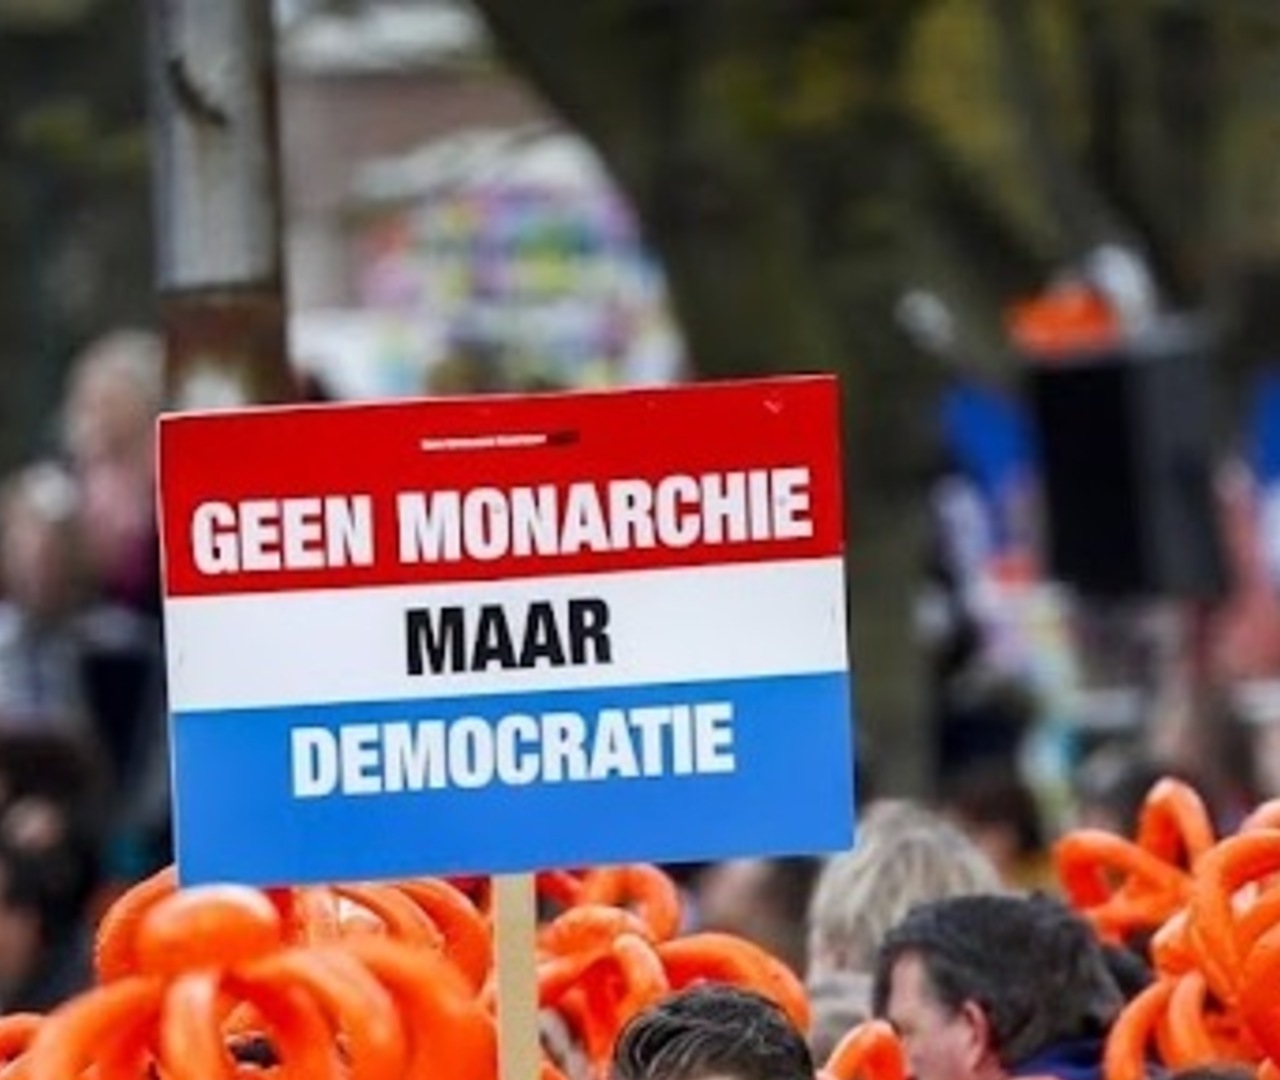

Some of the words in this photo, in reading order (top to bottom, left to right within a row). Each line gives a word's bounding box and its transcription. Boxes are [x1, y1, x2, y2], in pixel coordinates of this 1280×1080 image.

[191, 495, 375, 575] GEEN
[397, 467, 814, 563] MONARCHIE
[405, 598, 612, 676] MAAR
[291, 702, 736, 797] DEMOCRATIE
